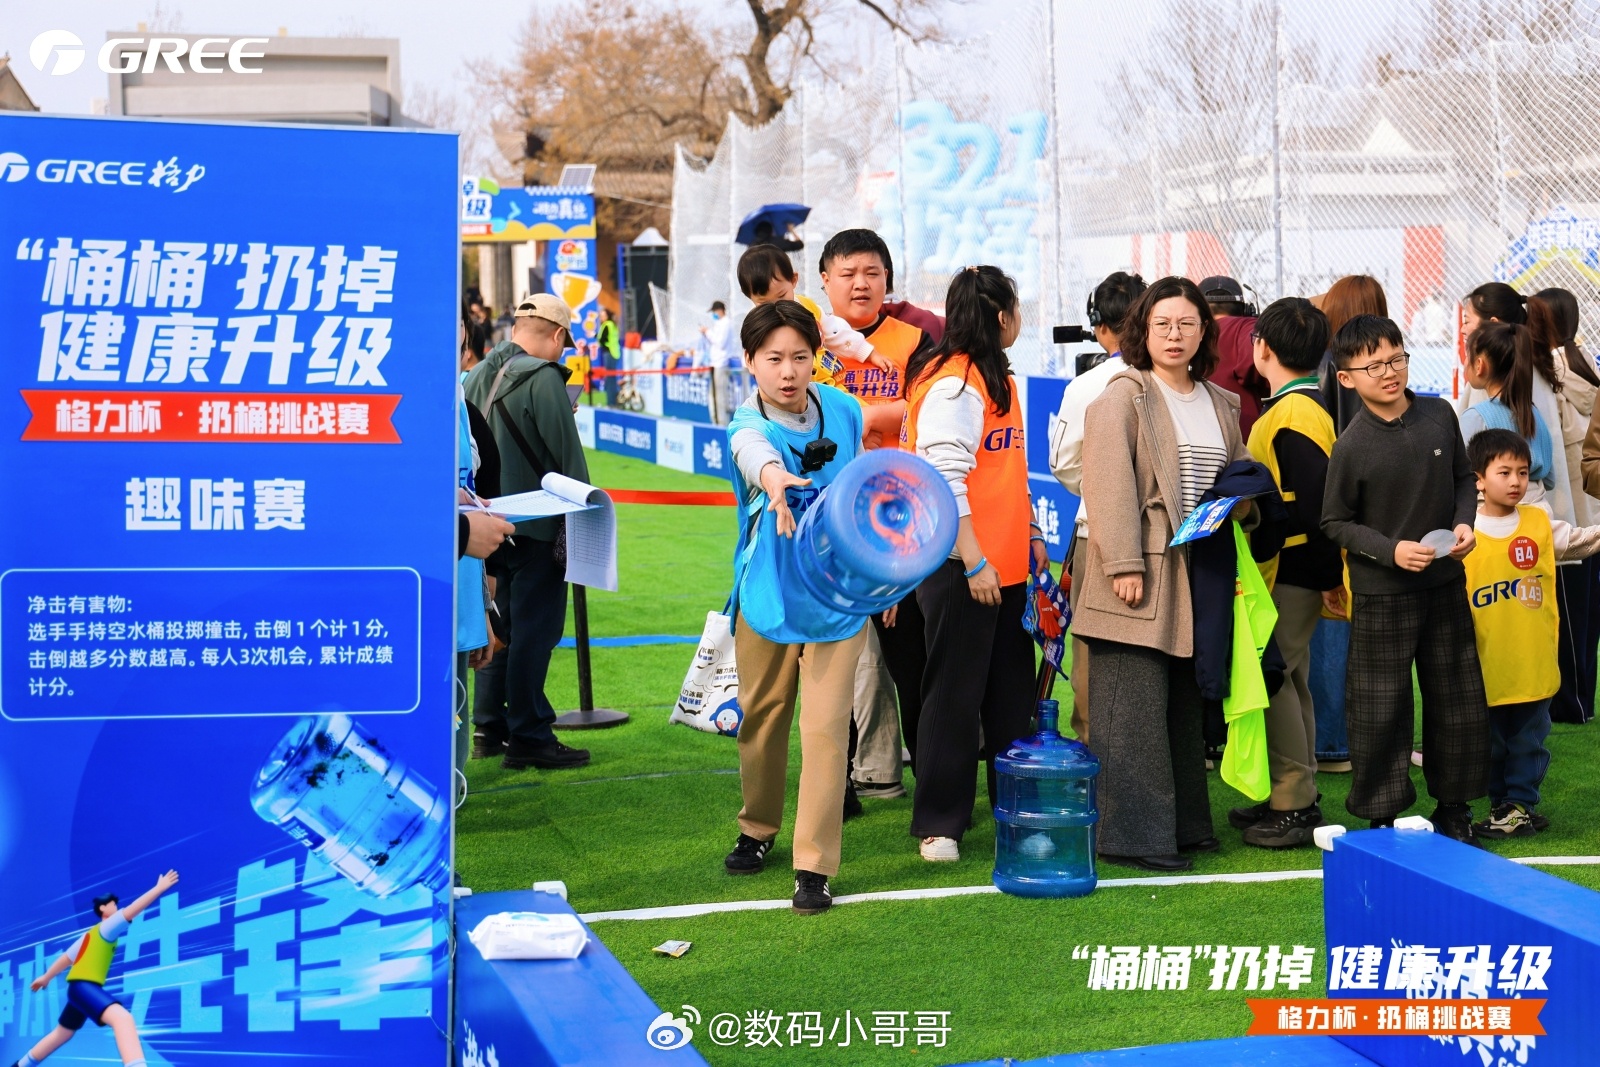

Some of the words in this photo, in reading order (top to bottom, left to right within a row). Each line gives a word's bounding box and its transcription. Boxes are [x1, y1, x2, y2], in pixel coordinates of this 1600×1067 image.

[36, 158, 147, 187] GREE
[16, 236, 399, 313] “桶桶”扔掉
[37, 309, 394, 387] 健康升级
[125, 476, 306, 531] 趣味赛
[28, 677, 76, 697] 计分。
